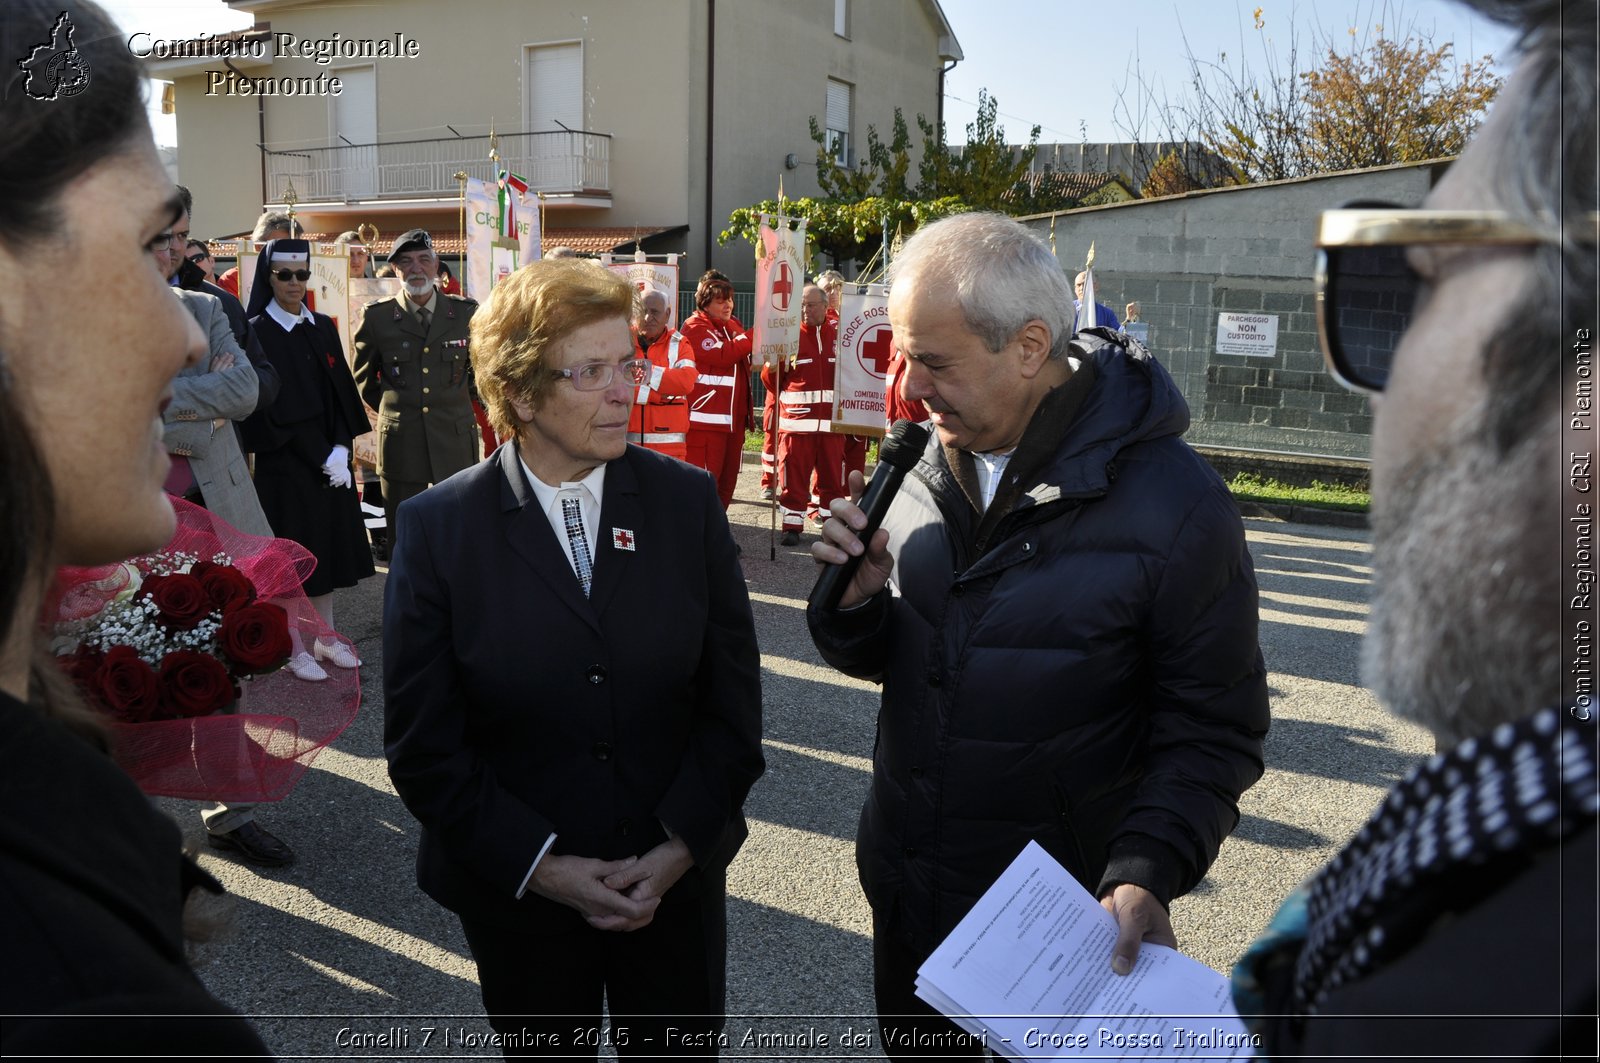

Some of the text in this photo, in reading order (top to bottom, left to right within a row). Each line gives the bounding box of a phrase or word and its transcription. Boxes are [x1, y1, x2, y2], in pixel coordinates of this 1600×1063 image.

[1227, 315, 1269, 324] PARCHEGGIO
[842, 316, 864, 348] CROCE
[1238, 324, 1257, 333] NON
[1227, 332, 1267, 341] CUSTODITO
[854, 390, 880, 400] COMITATO
